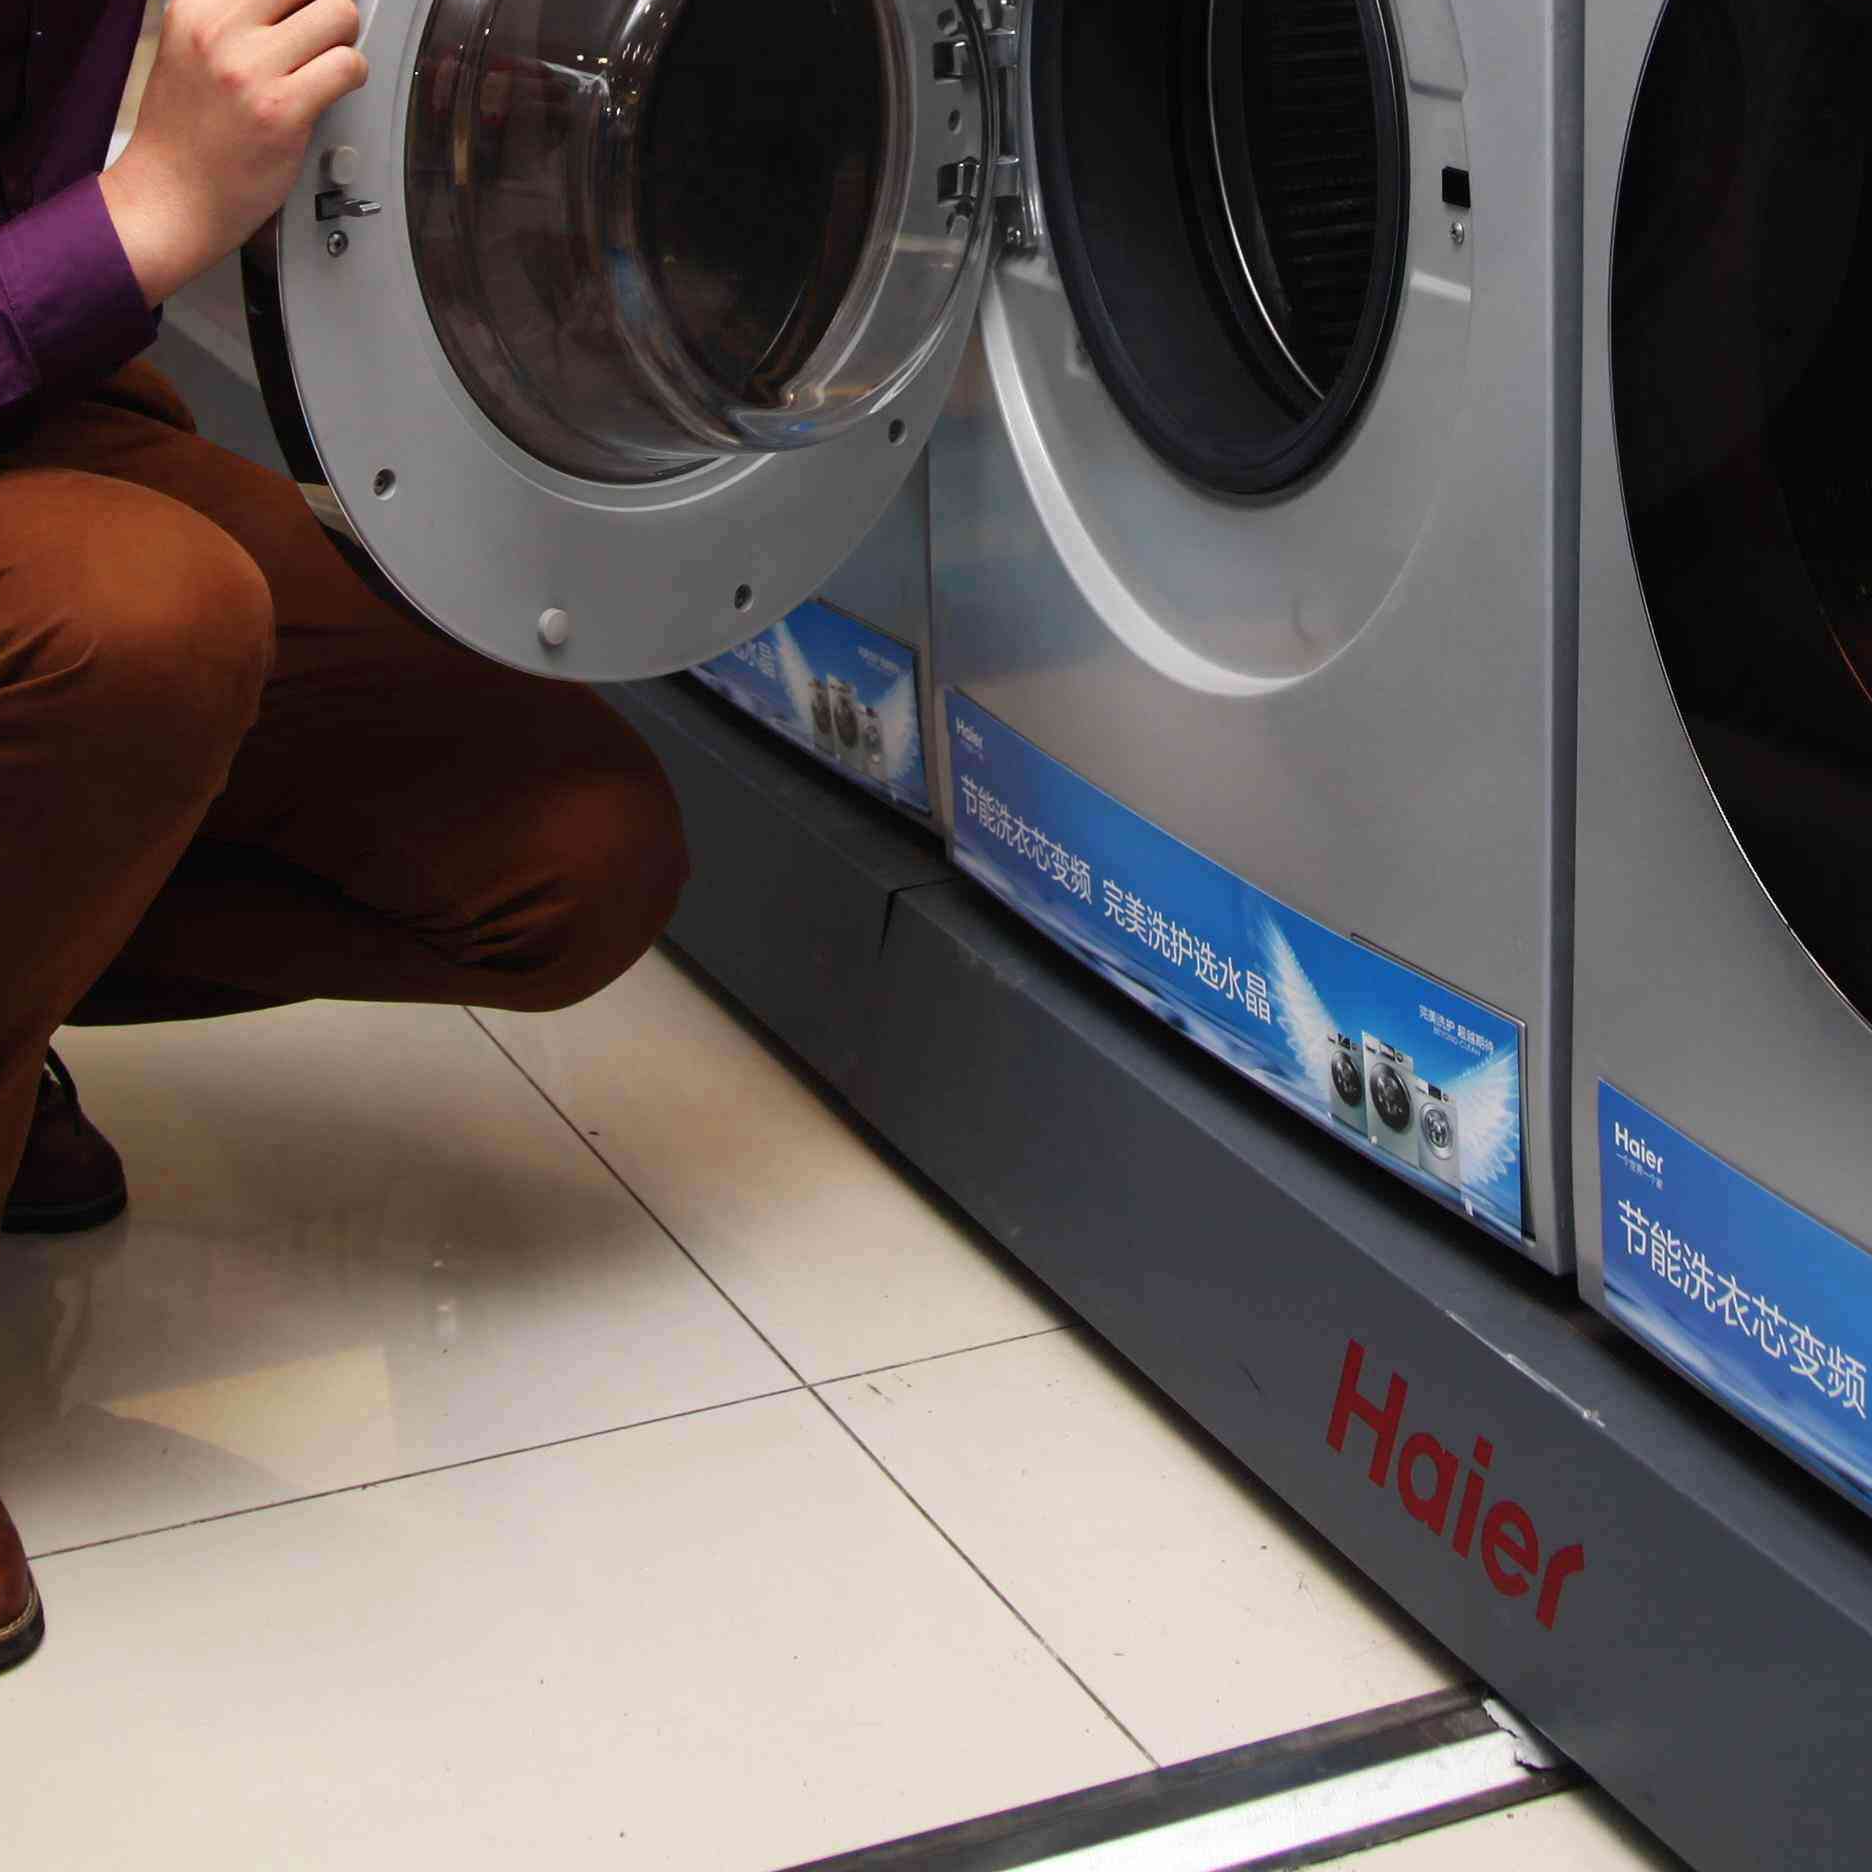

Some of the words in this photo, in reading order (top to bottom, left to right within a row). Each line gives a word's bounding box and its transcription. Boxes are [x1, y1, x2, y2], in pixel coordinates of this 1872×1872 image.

[960, 774, 1093, 905] 节能洗衣芯变频
[1103, 879, 1271, 1025] 完美洗护选水晶
[1614, 1121, 1664, 1174] Haier
[1618, 1199, 1867, 1420] 节能洗衣芯变频
[1326, 1338, 1585, 1631] Haier
